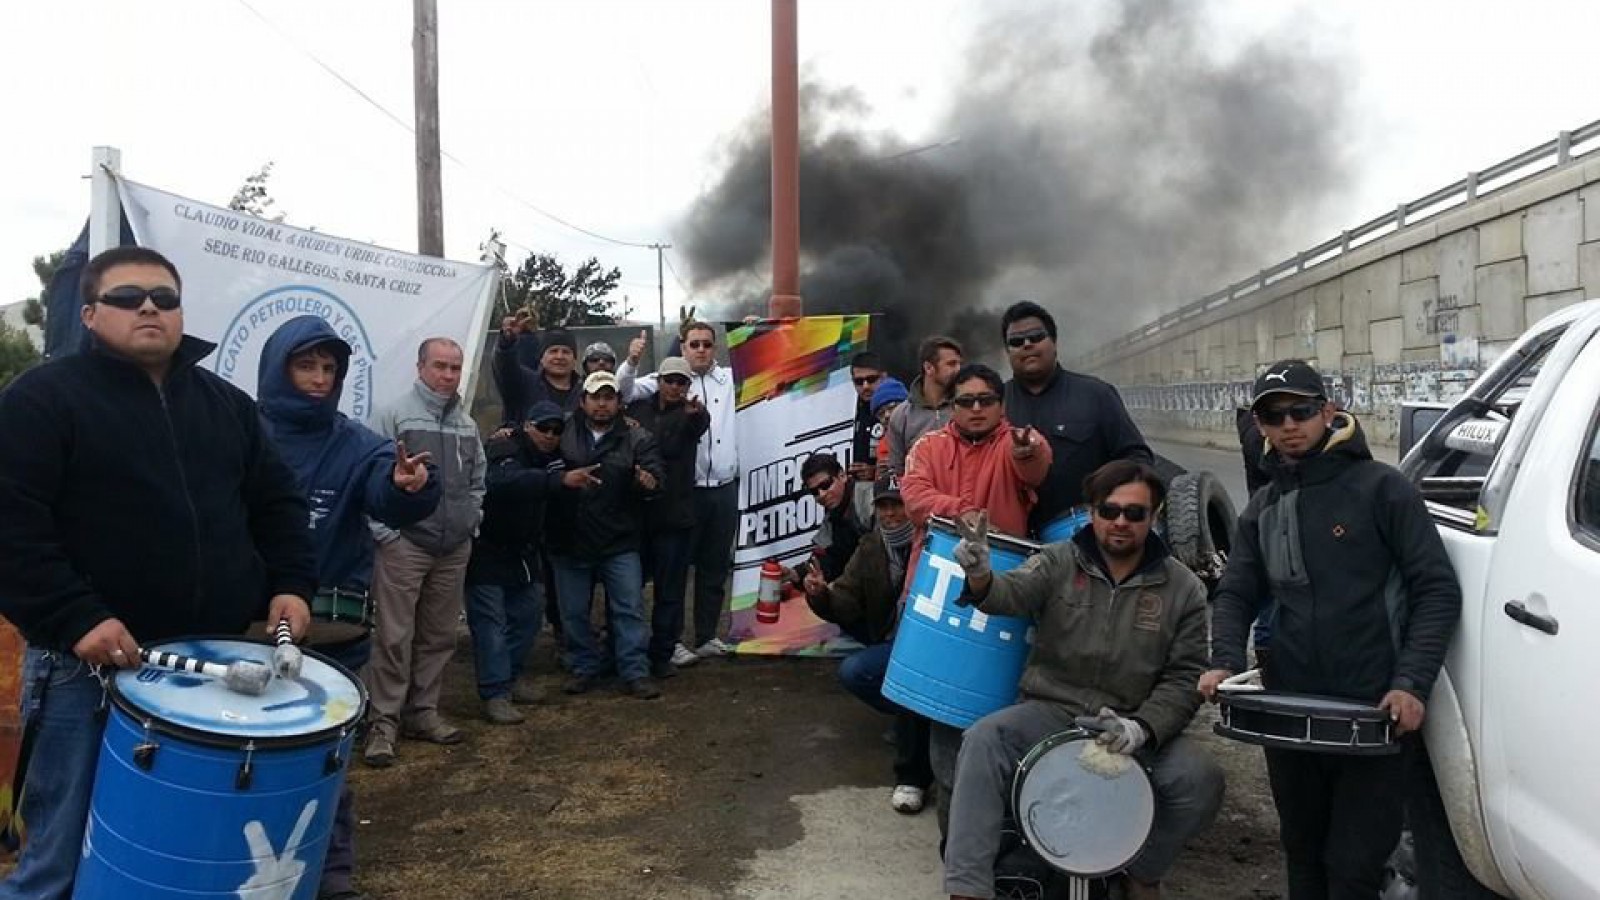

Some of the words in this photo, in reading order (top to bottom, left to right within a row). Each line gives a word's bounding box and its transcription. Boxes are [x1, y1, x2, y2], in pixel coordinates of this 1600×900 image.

[174, 203, 239, 231] CLAUDIO
[242, 221, 283, 242] VIDAL
[297, 235, 342, 251] RUBEN
[344, 246, 385, 265] URIBE
[204, 238, 240, 259] SEDE
[242, 247, 266, 264] RIO
[344, 269, 387, 291] SANTA
[389, 279, 423, 295] CRUZ
[221, 324, 249, 379] ICATO
[250, 297, 332, 329] PETROLERO
[333, 312, 344, 326] Y
[340, 324, 362, 355] GAS
[1458, 424, 1494, 441] HILUX
